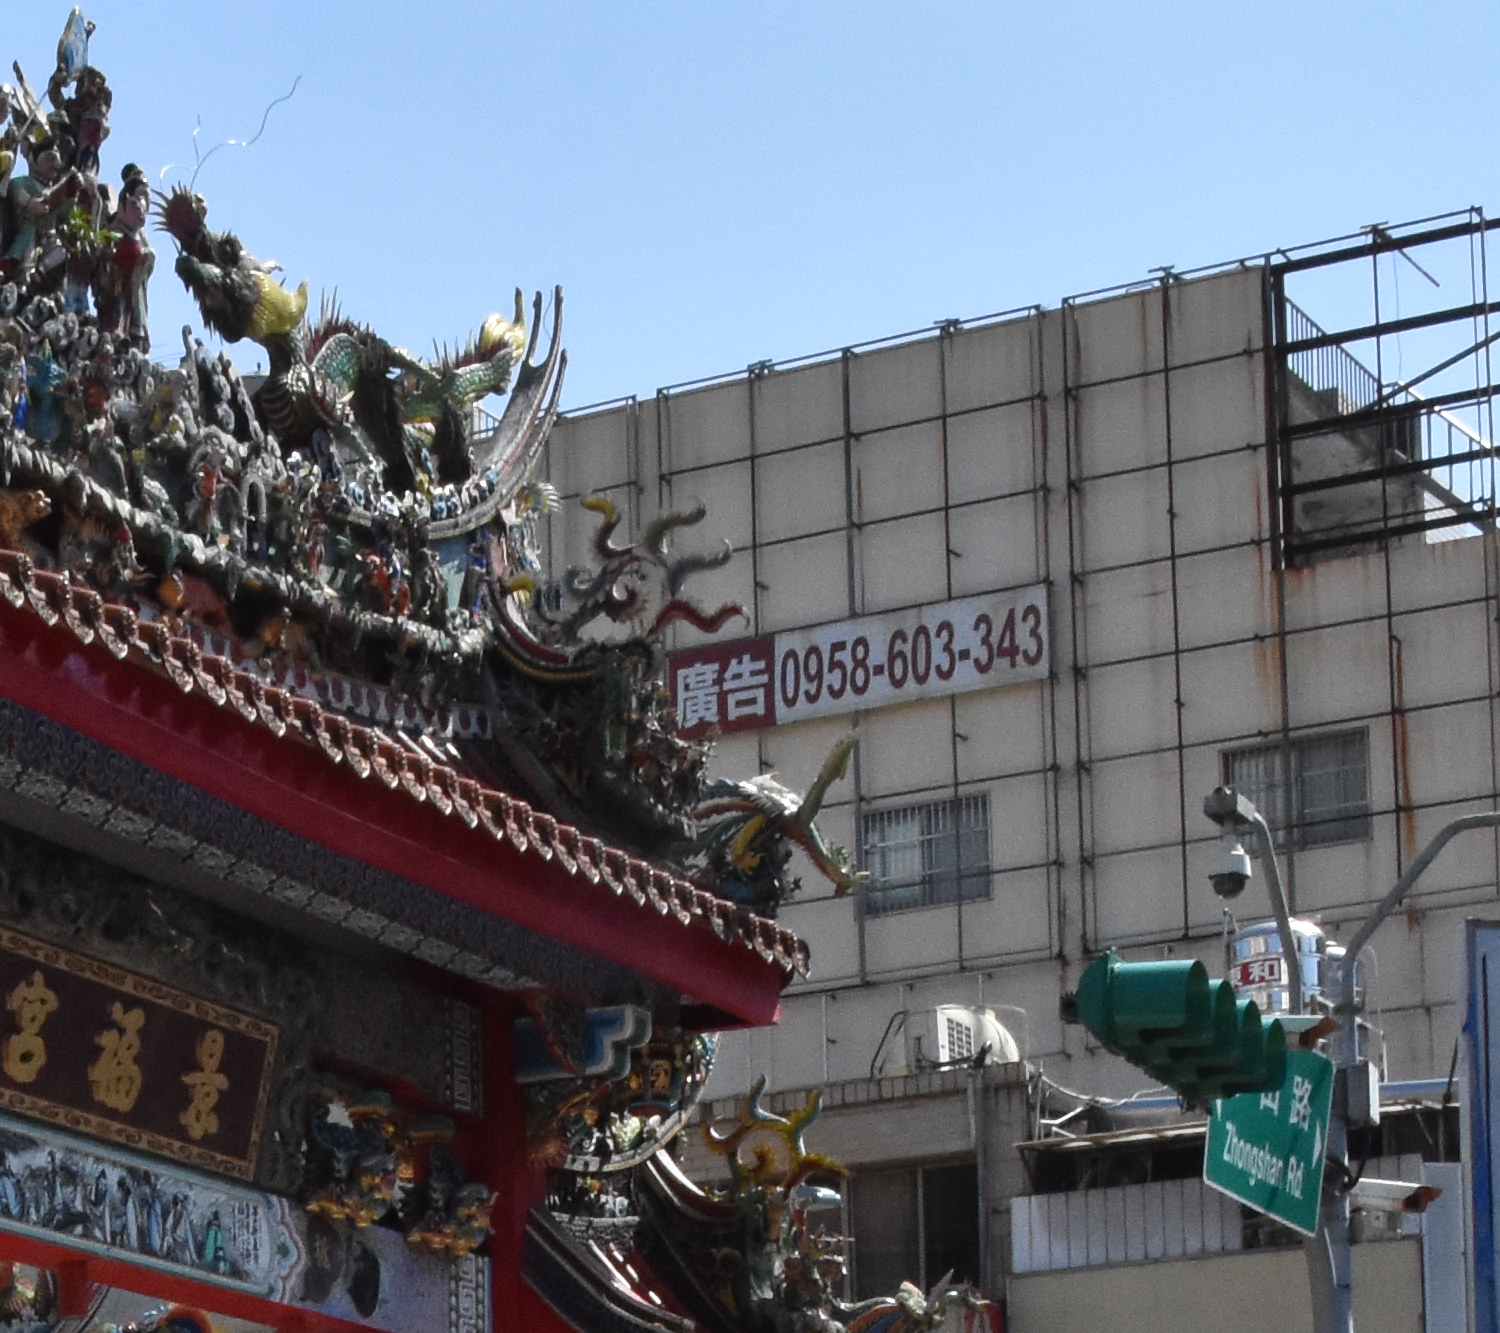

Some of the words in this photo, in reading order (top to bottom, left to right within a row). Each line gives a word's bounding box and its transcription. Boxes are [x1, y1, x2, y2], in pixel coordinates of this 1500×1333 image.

[676, 655, 769, 730] 廣告
[780, 605, 1044, 708] 0958-603-343
[1223, 1121, 1283, 1188] Zhongshan
